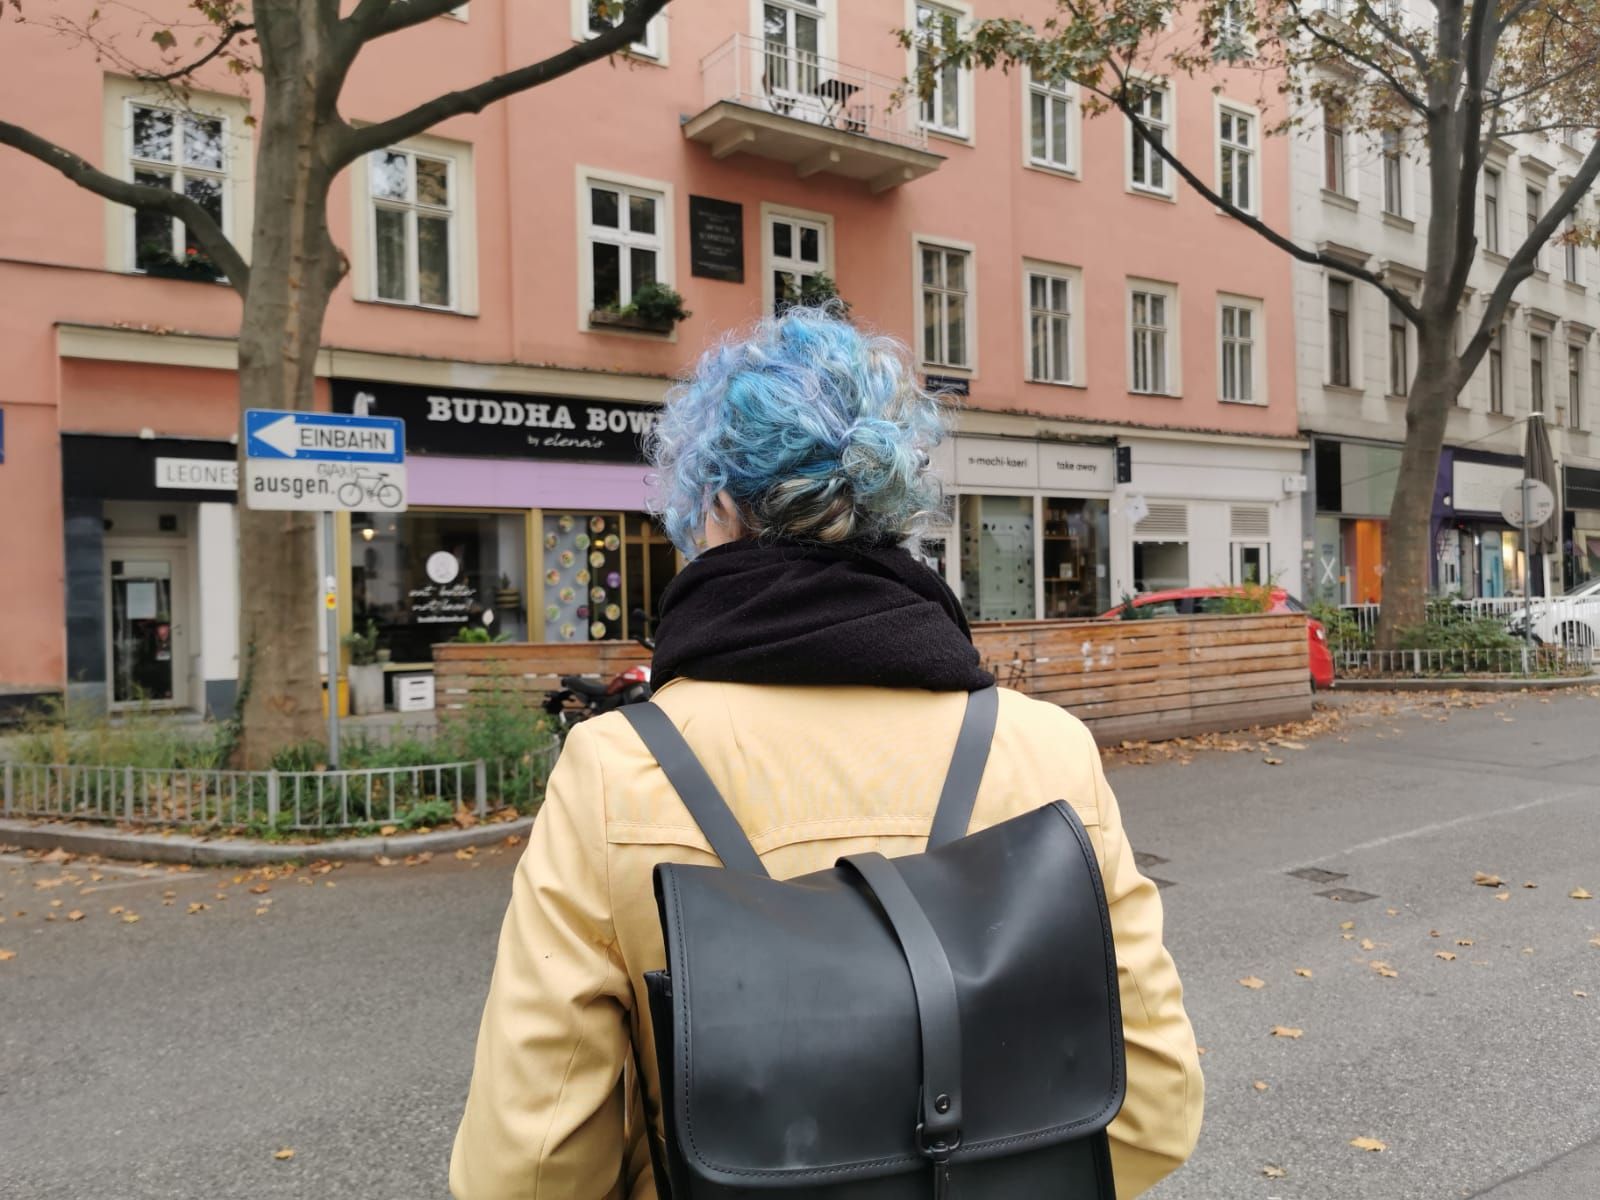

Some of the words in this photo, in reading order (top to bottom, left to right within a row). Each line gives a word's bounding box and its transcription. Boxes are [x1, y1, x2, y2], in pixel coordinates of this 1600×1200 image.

[427, 396, 576, 430] BUDDHA
[300, 427, 387, 450] EINBAHN
[1056, 460, 1074, 471] take
[1075, 463, 1097, 473] away
[253, 475, 336, 499] ausgen.
